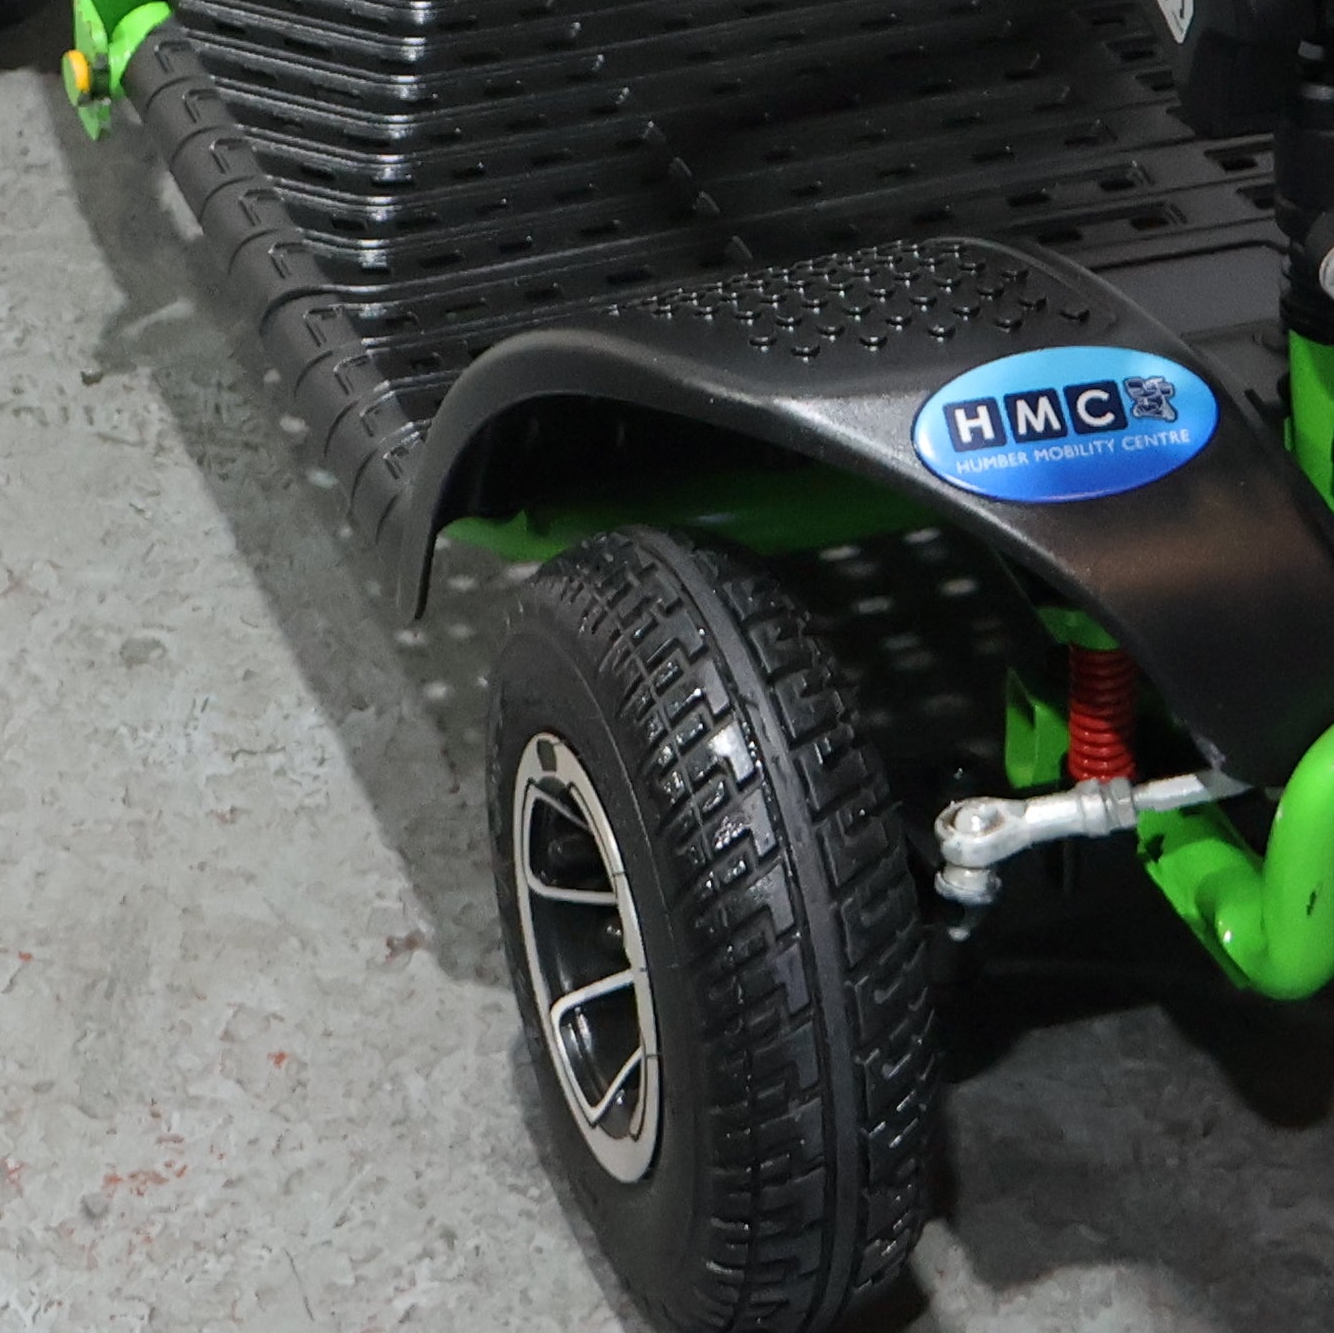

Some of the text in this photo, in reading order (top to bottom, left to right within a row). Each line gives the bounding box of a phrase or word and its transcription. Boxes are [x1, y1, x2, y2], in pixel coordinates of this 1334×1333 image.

[956, 429, 1190, 475] HUMBER MOBILITY CENTRE
